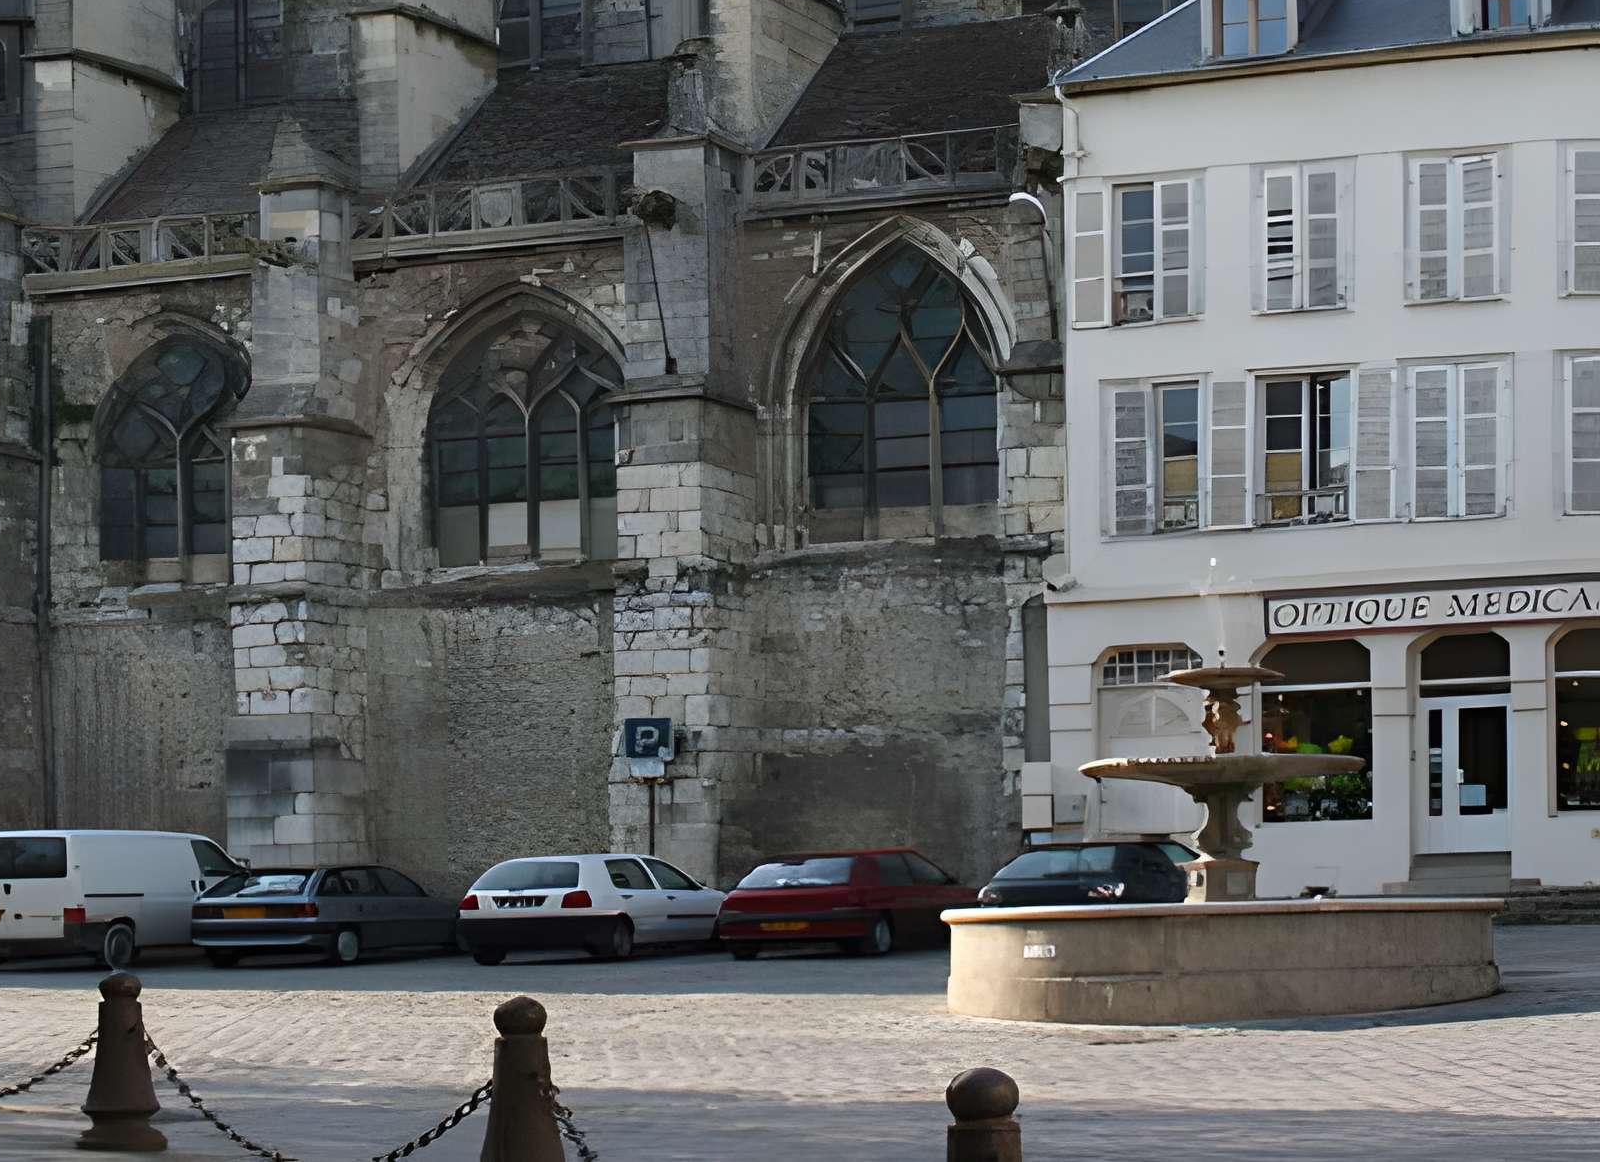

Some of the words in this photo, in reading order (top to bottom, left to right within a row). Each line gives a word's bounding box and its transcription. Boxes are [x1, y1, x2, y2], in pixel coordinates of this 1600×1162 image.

[1273, 595, 1431, 628] OPTIQUE
[1446, 587, 1600, 617] MEDICA
[635, 726, 659, 753] P
